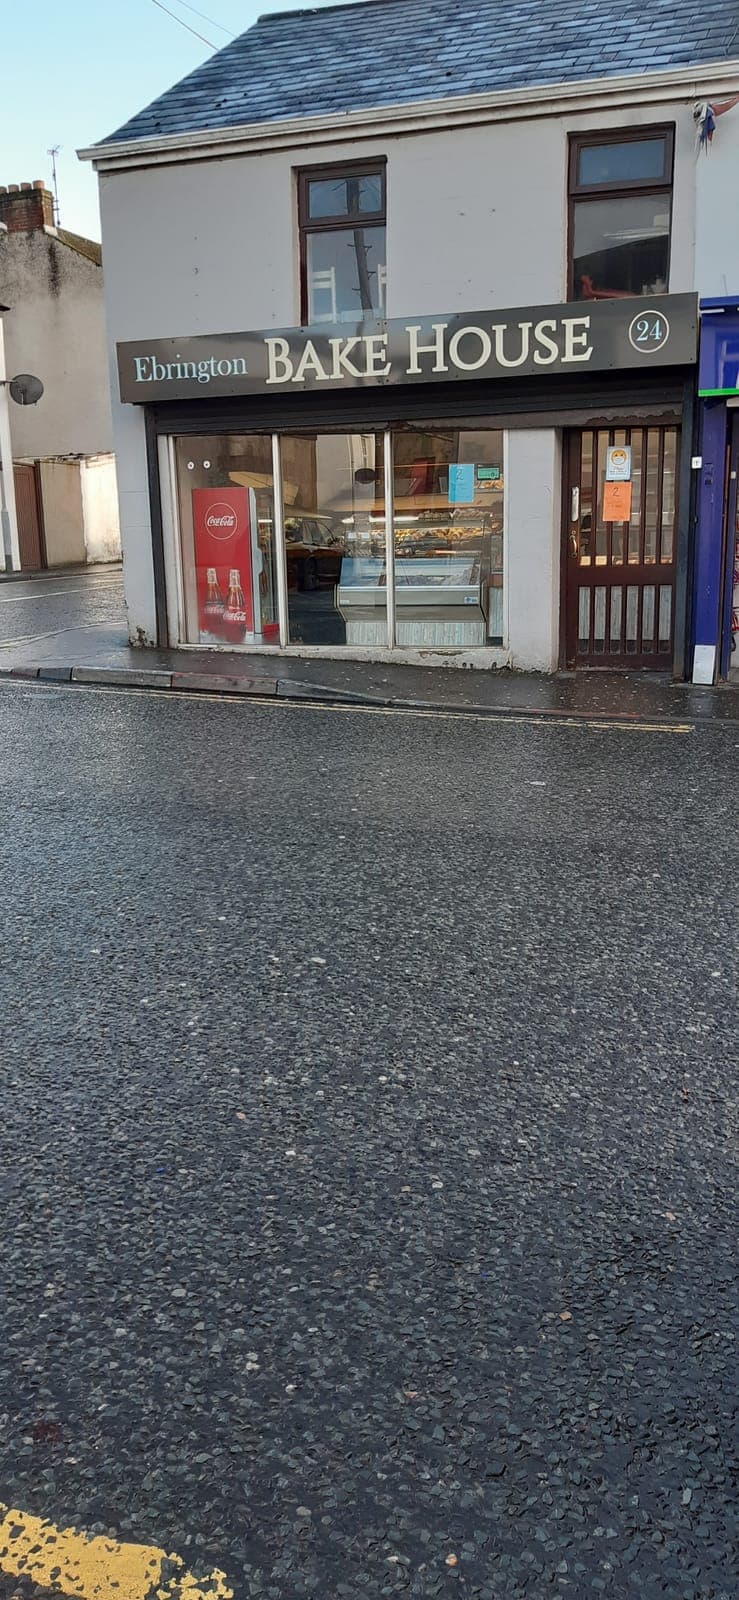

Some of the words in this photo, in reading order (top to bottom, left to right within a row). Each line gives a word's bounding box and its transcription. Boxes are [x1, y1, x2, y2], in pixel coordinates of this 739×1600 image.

[134, 353, 248, 384] Ebrington
[264, 334, 392, 384] BAKE
[405, 316, 593, 374] HOUSE
[636, 320, 663, 341] 24
[612, 486, 620, 498] 2
